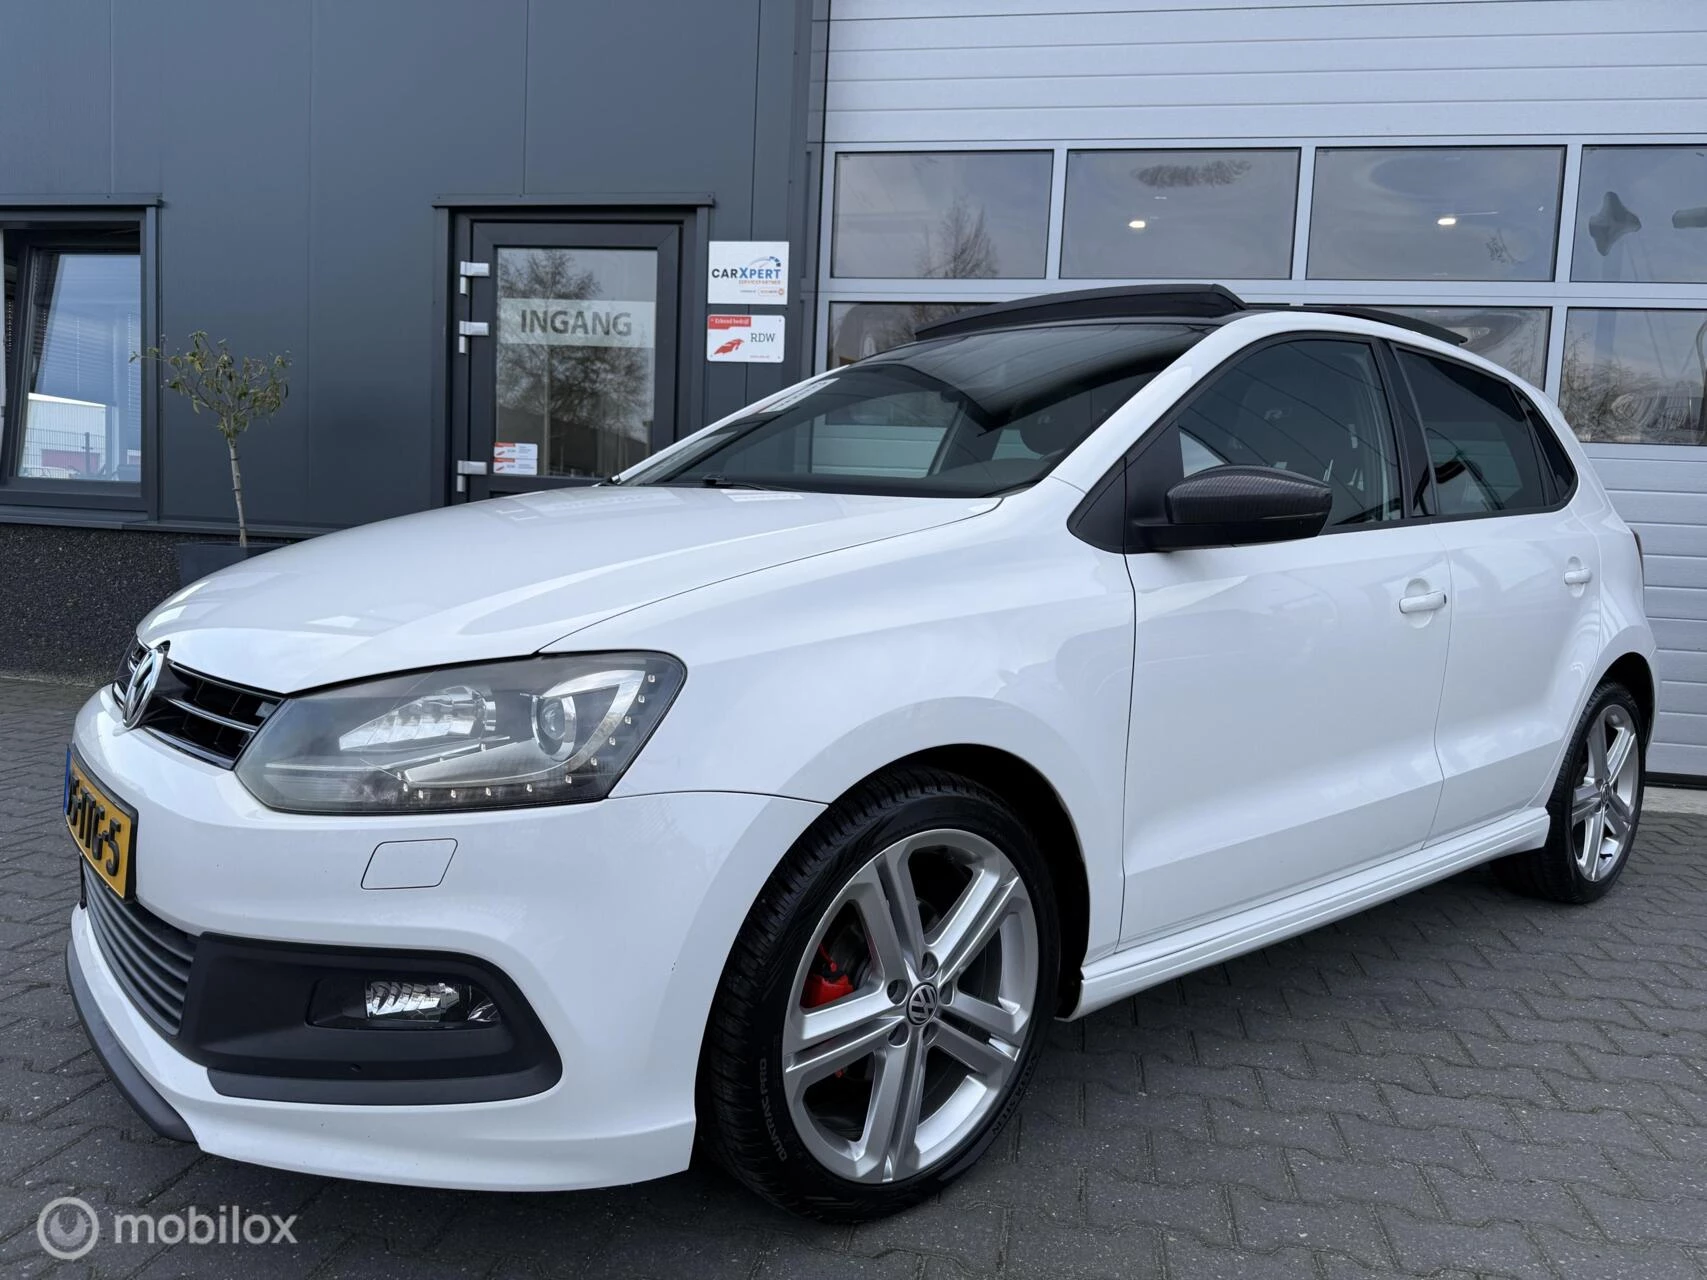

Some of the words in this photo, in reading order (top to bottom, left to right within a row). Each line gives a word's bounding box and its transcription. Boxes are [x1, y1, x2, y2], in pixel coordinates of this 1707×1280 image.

[711, 267, 781, 279] CARXPERT
[520, 309, 632, 337] INGANG
[750, 332, 775, 343] RDW
